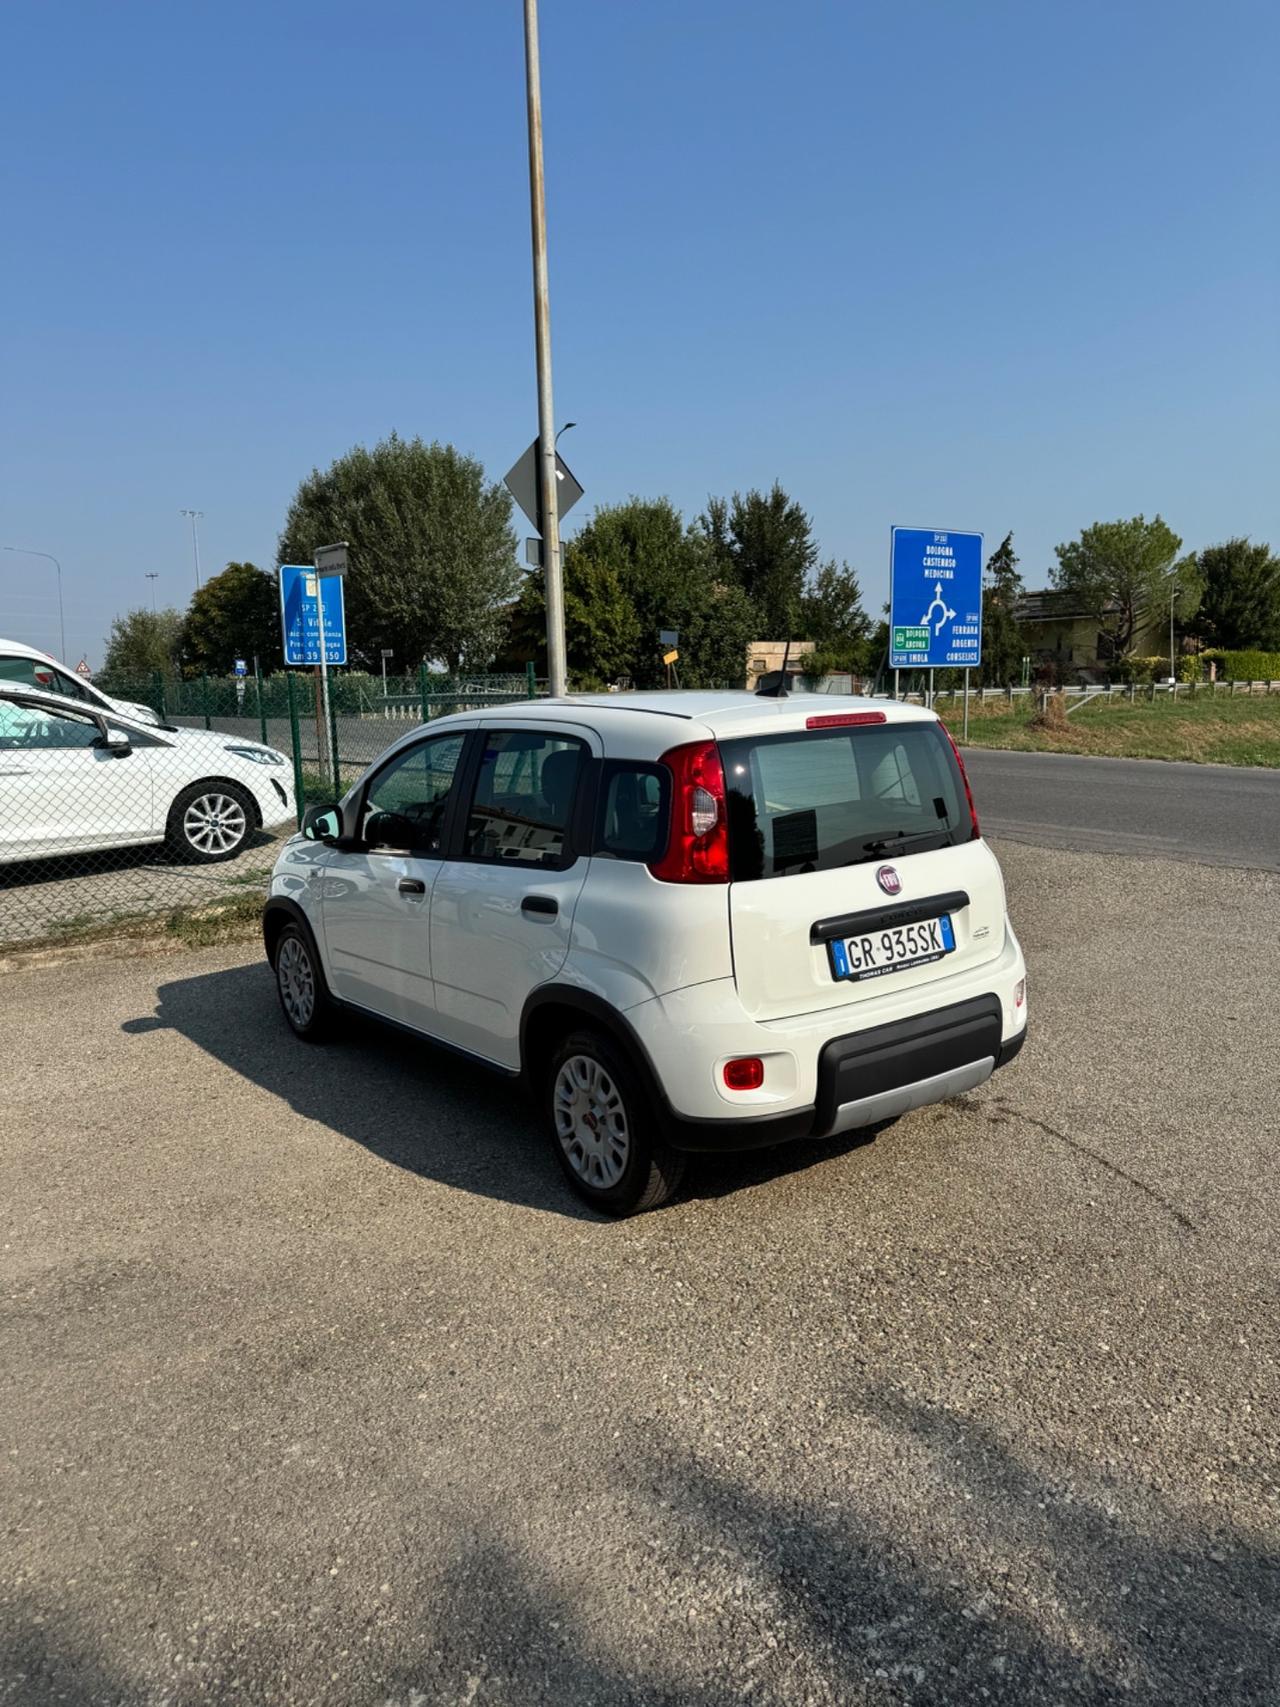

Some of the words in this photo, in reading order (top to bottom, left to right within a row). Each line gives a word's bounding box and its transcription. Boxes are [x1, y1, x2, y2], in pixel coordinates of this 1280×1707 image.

[926, 545, 953, 556] BOLOGNA
[923, 557, 956, 568] CASTENASO
[924, 569, 954, 579] MEDICINA
[301, 604, 310, 612] SP
[905, 629, 929, 638] BOLOGNA
[952, 625, 978, 635] FERRARA
[905, 640, 926, 649] ANCONA
[952, 639, 978, 648] ARGENTA
[292, 651, 304, 660] km
[908, 653, 929, 663] IMOLA
[946, 652, 977, 662] CONSELICE
[847, 939, 877, 969] GR
[880, 922, 942, 961] 935SK
[859, 968, 881, 979] THOMAS
[881, 966, 893, 975] CAR
